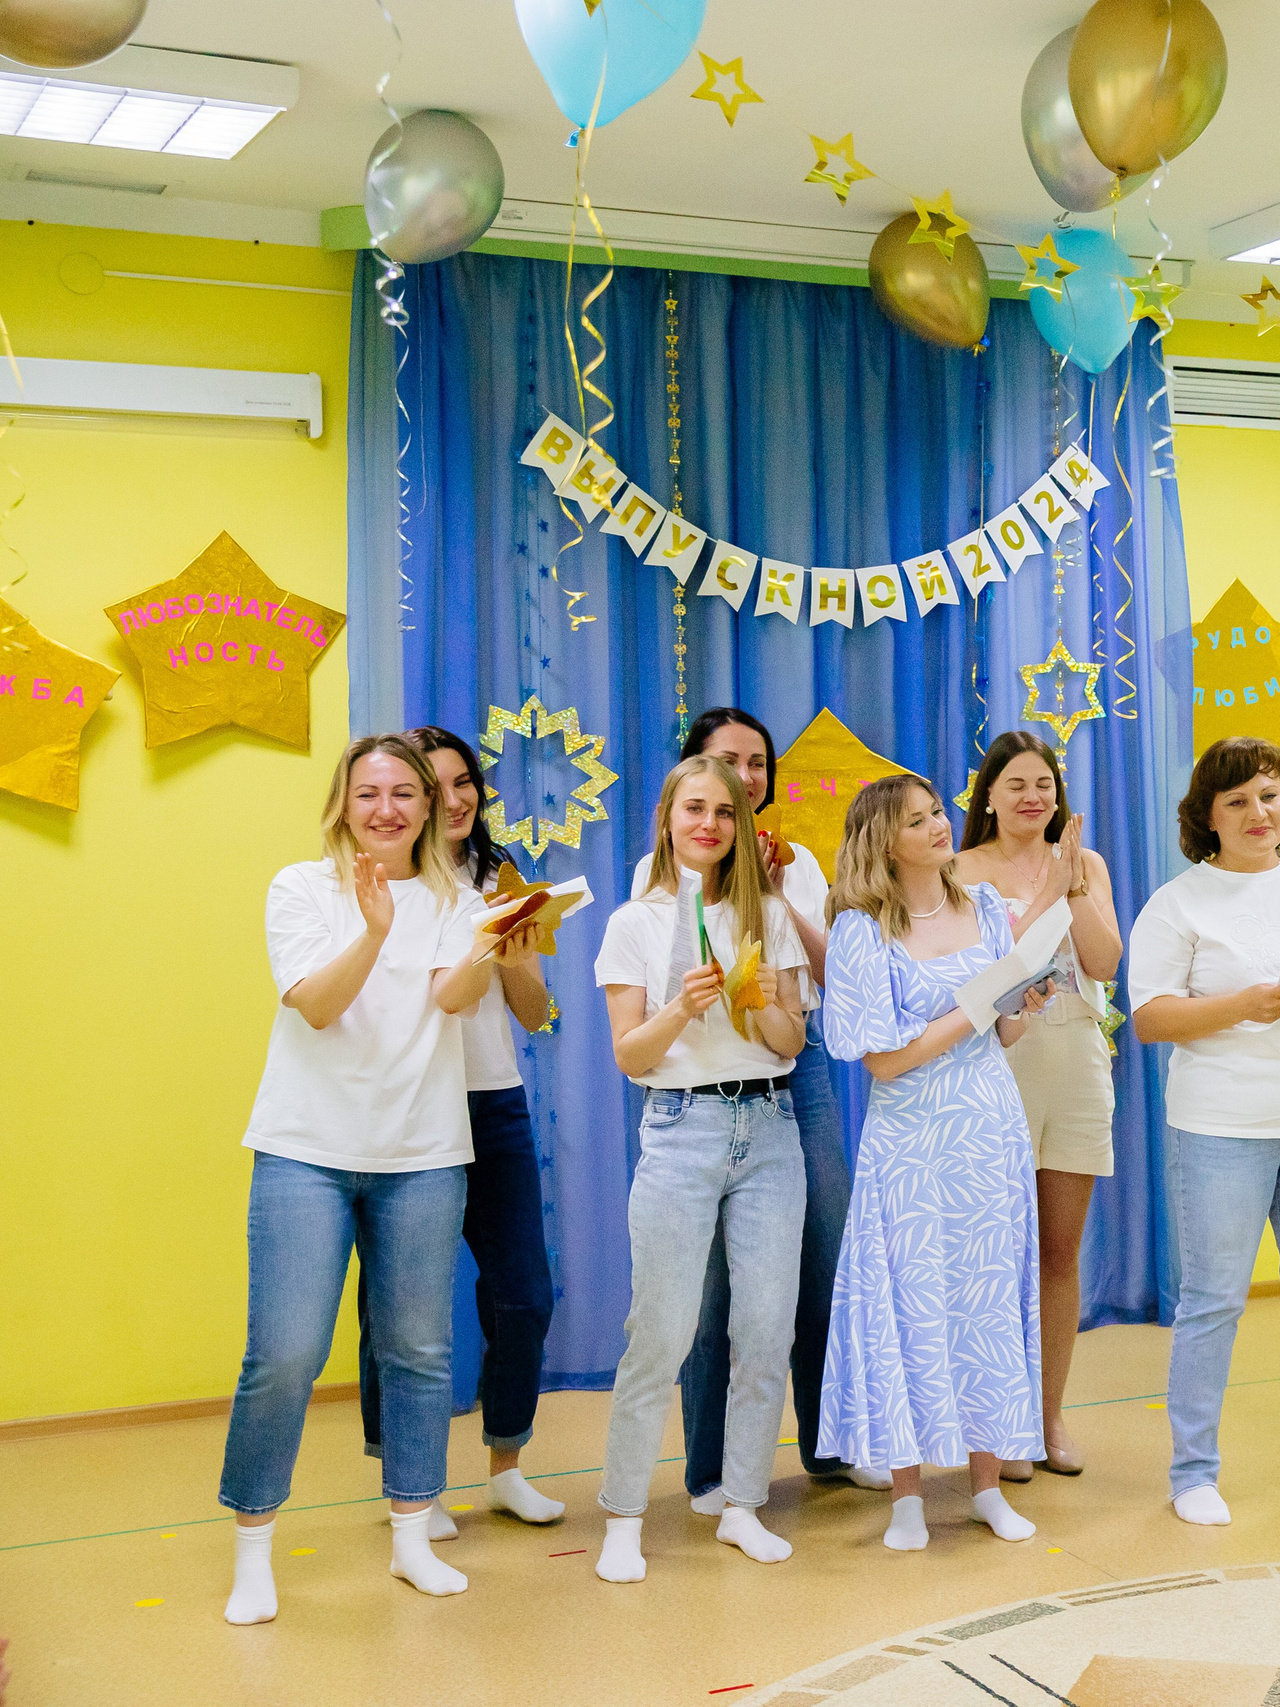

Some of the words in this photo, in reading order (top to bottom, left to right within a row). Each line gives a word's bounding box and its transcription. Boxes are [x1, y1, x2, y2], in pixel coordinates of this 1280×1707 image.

[535, 426, 948, 613] ВЫПУСКНОЙ
[963, 457, 1094, 579] 2024
[118, 593, 328, 649] ЛЮБОЗНАТЕЛЬ
[168, 641, 285, 672] НОСТЬ
